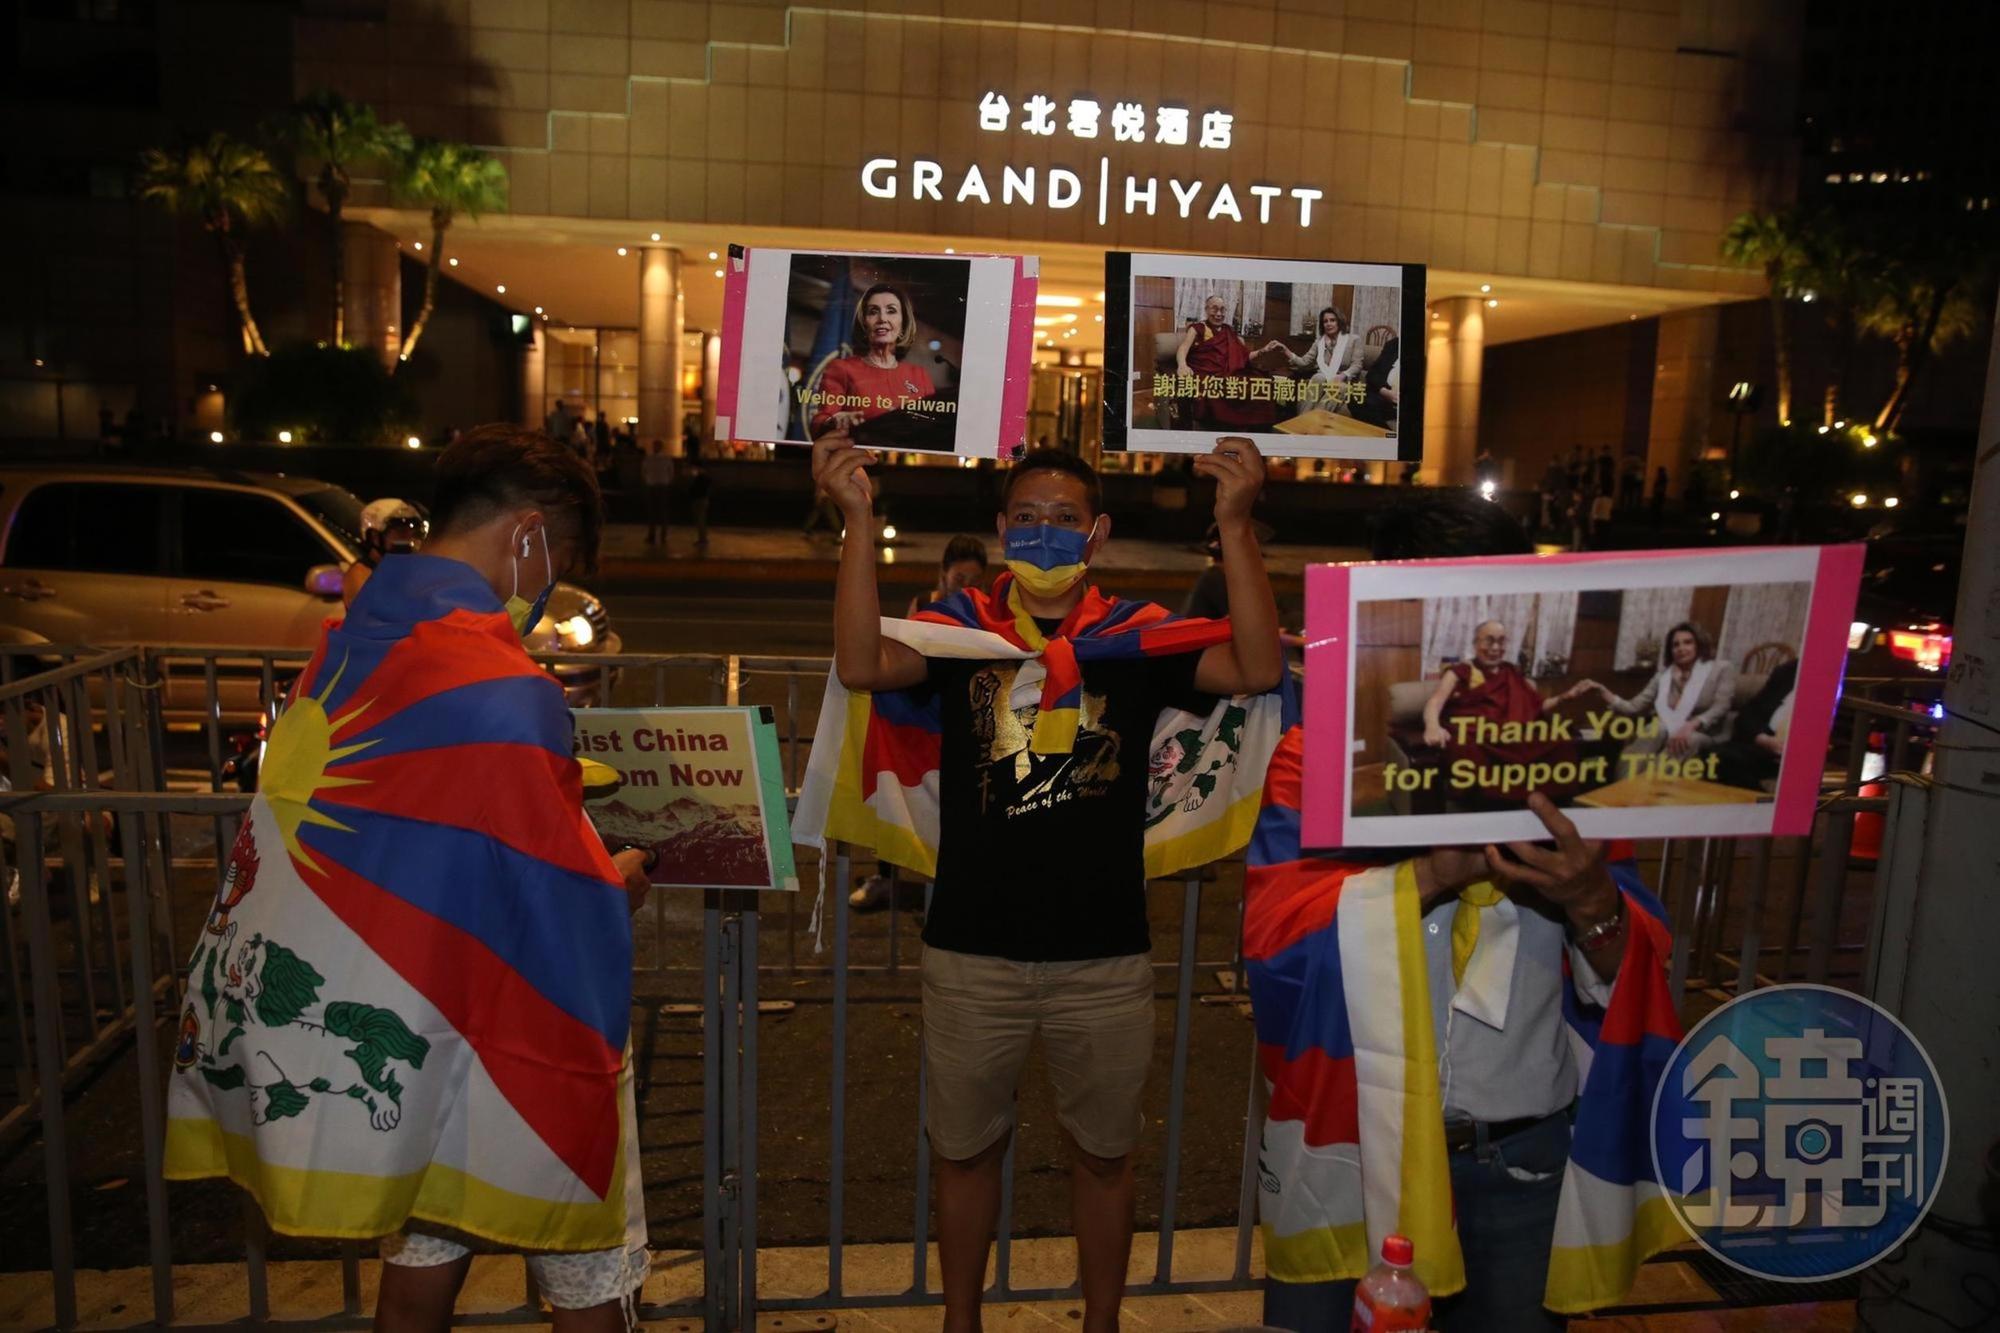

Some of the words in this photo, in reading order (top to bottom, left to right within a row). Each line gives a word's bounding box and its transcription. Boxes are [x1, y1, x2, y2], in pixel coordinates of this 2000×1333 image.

[861, 157, 1082, 209] GRAND
[1125, 175, 1323, 228] HYATT
[796, 388, 872, 408] Welcome
[876, 394, 893, 409] to
[898, 395, 957, 413] Taiwan
[1152, 372, 1368, 405] 謝謝您對西藏的支持
[632, 728, 729, 753] China
[1449, 713, 1573, 746] Thank
[1586, 710, 1660, 740] You
[669, 763, 744, 787] Now
[1382, 764, 1439, 792] for
[1449, 754, 1608, 794] Support
[1621, 749, 1720, 783] Tibet
[1005, 801, 1039, 820] Peace
[1041, 792, 1053, 809] of
[1056, 788, 1074, 803] the
